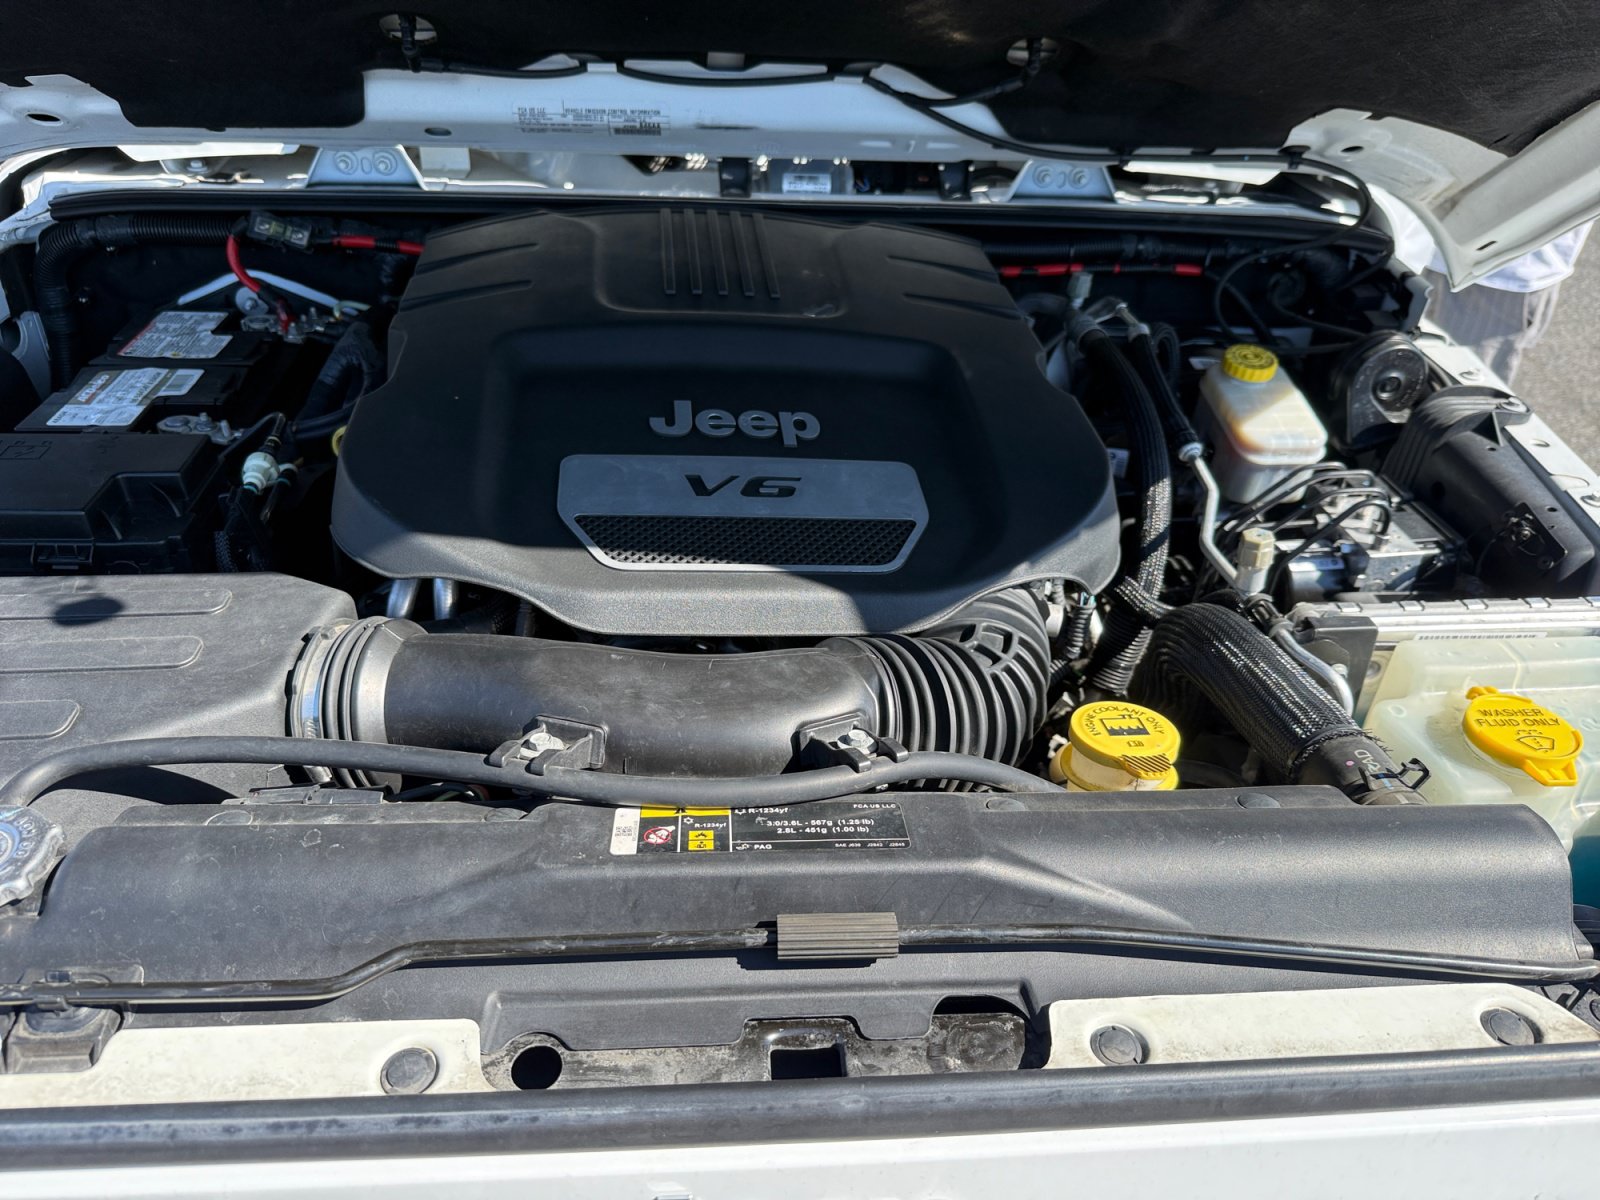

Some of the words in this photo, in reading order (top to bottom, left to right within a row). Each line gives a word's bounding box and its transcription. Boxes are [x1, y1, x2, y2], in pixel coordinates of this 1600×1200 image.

[649, 400, 820, 448] Jeep
[684, 474, 802, 498] V6
[1085, 713, 1101, 736] ENGINE
[1093, 706, 1146, 717] COOLANT
[1146, 716, 1164, 734] ONLY
[1475, 718, 1520, 726] FLUID
[1523, 718, 1561, 726] ONLY
[1477, 708, 1544, 717] WASHER
